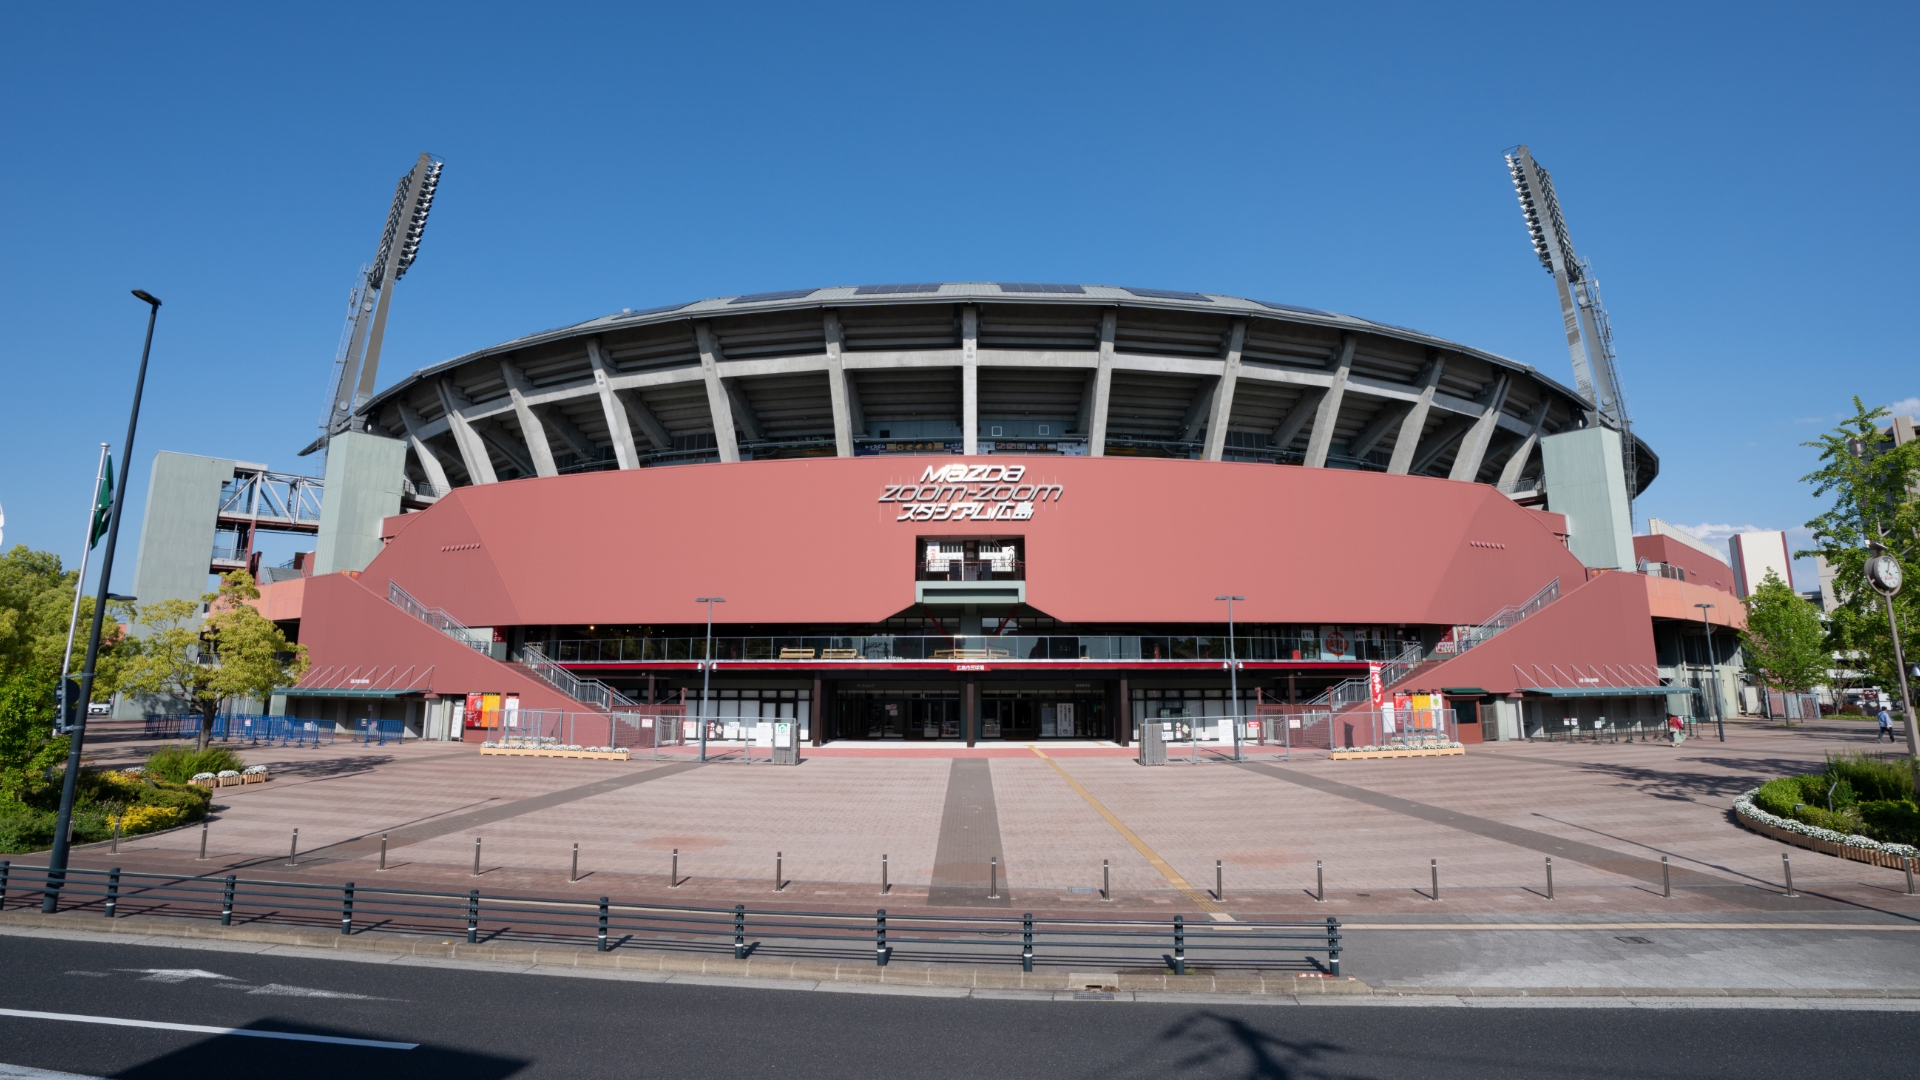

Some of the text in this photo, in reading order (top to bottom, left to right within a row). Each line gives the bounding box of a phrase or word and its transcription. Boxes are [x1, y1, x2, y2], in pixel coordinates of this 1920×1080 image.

[897, 501, 1035, 521] スタジアム広島
